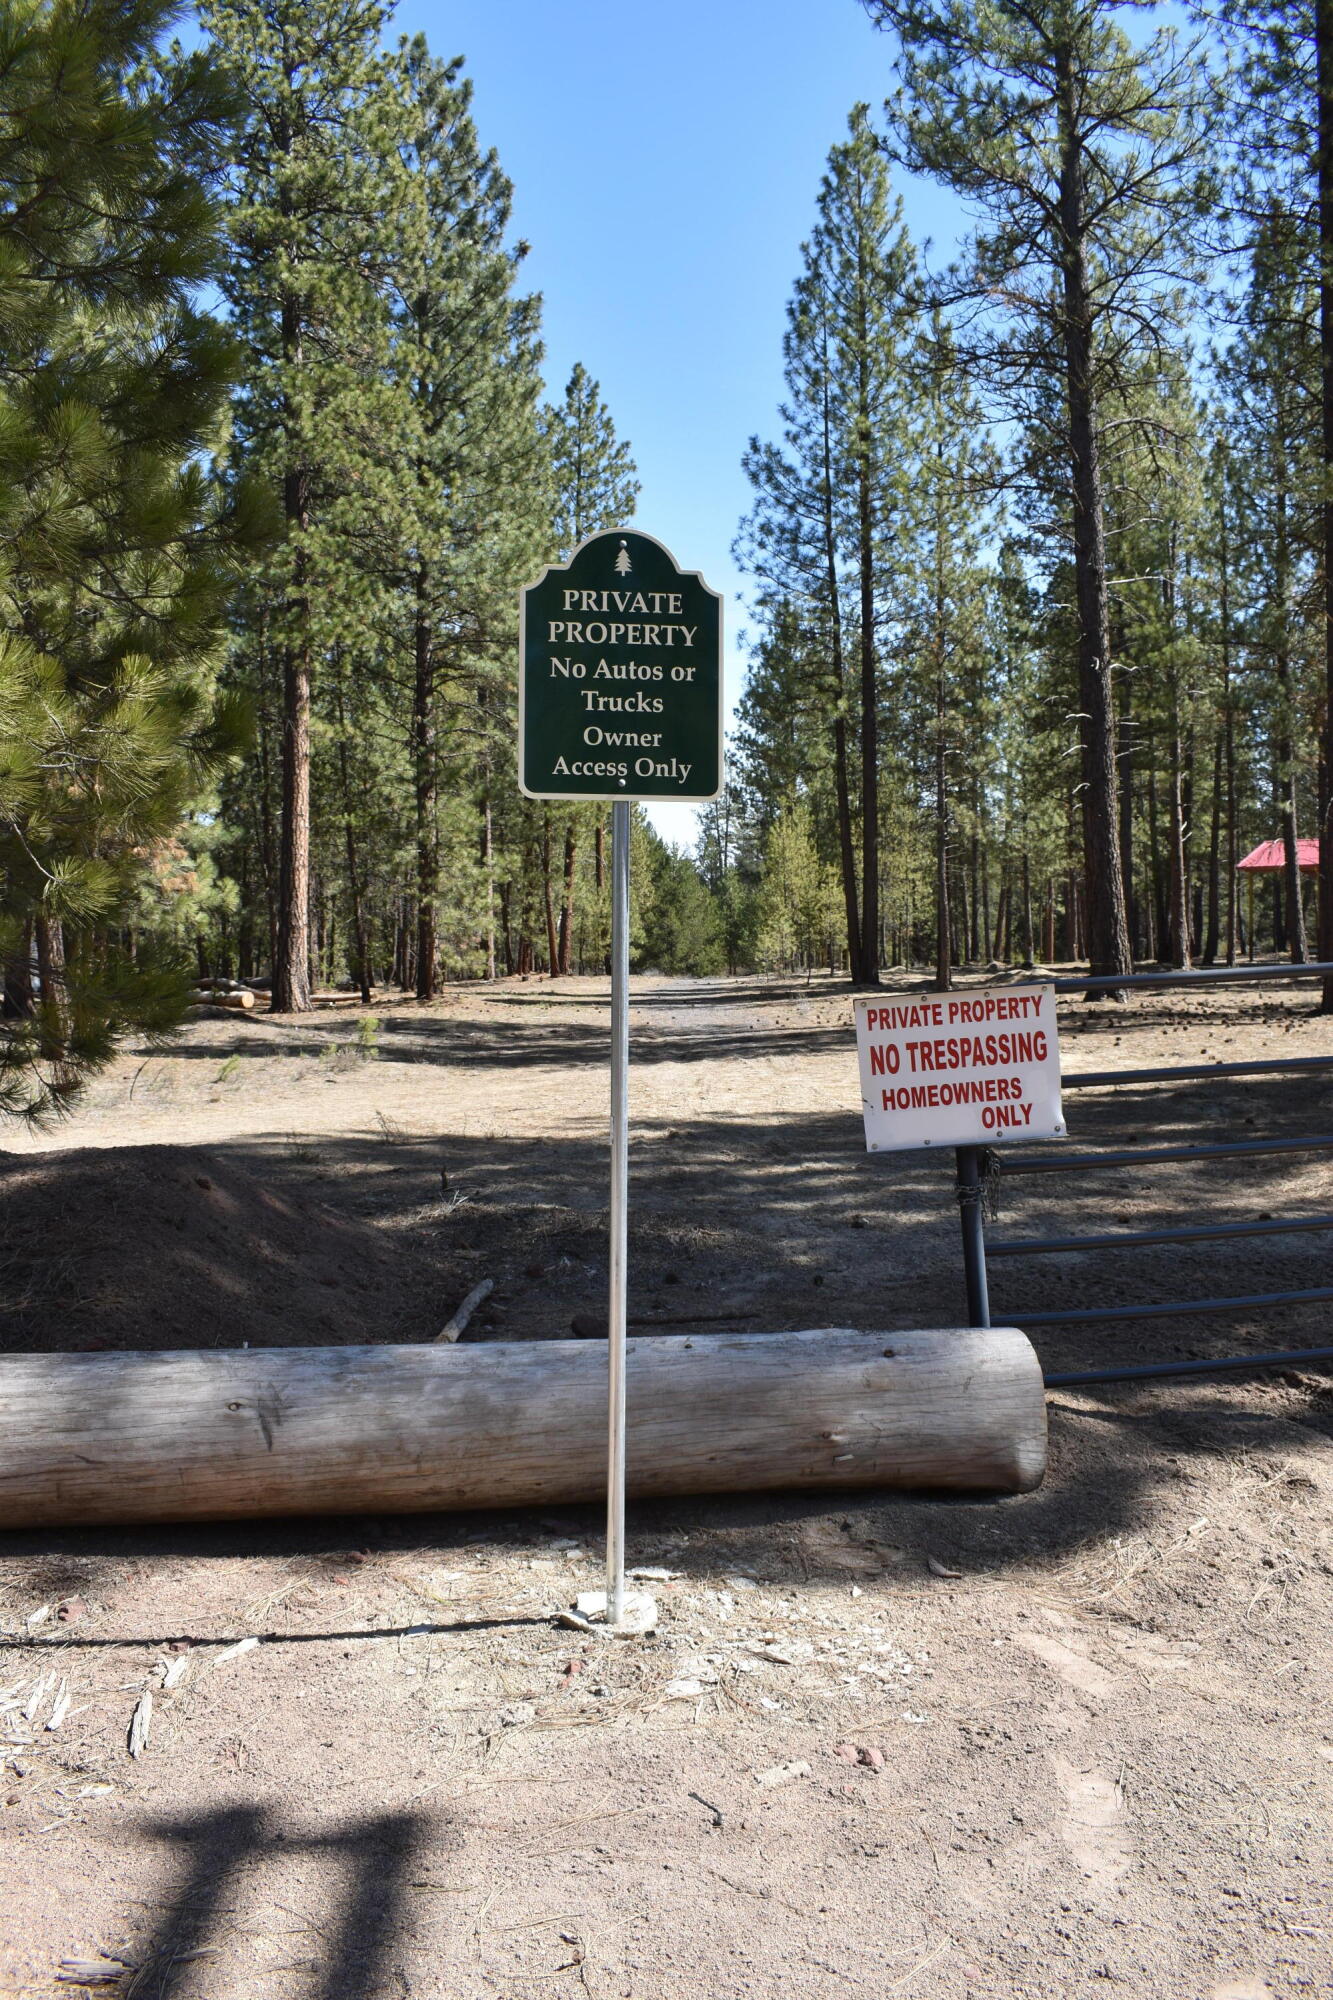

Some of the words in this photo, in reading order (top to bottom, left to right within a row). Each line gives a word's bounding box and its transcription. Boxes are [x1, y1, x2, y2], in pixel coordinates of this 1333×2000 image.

[562, 589, 683, 614] PRIVATE
[547, 621, 698, 647] PROPERTY
[549, 657, 587, 679] No
[592, 658, 664, 681] Autos
[670, 666, 696, 682] or
[580, 690, 664, 713] Trucks
[583, 726, 663, 747] Owner
[551, 755, 628, 777] Access
[634, 757, 693, 784] Only
[867, 1003, 943, 1031] PRIVATE
[948, 994, 1043, 1024] PROPERTY
[869, 1043, 900, 1076] NO
[905, 1030, 1048, 1073] TRESPASSING
[881, 1077, 1023, 1111] HOMEOWNERS
[981, 1103, 1033, 1129] ONLY
